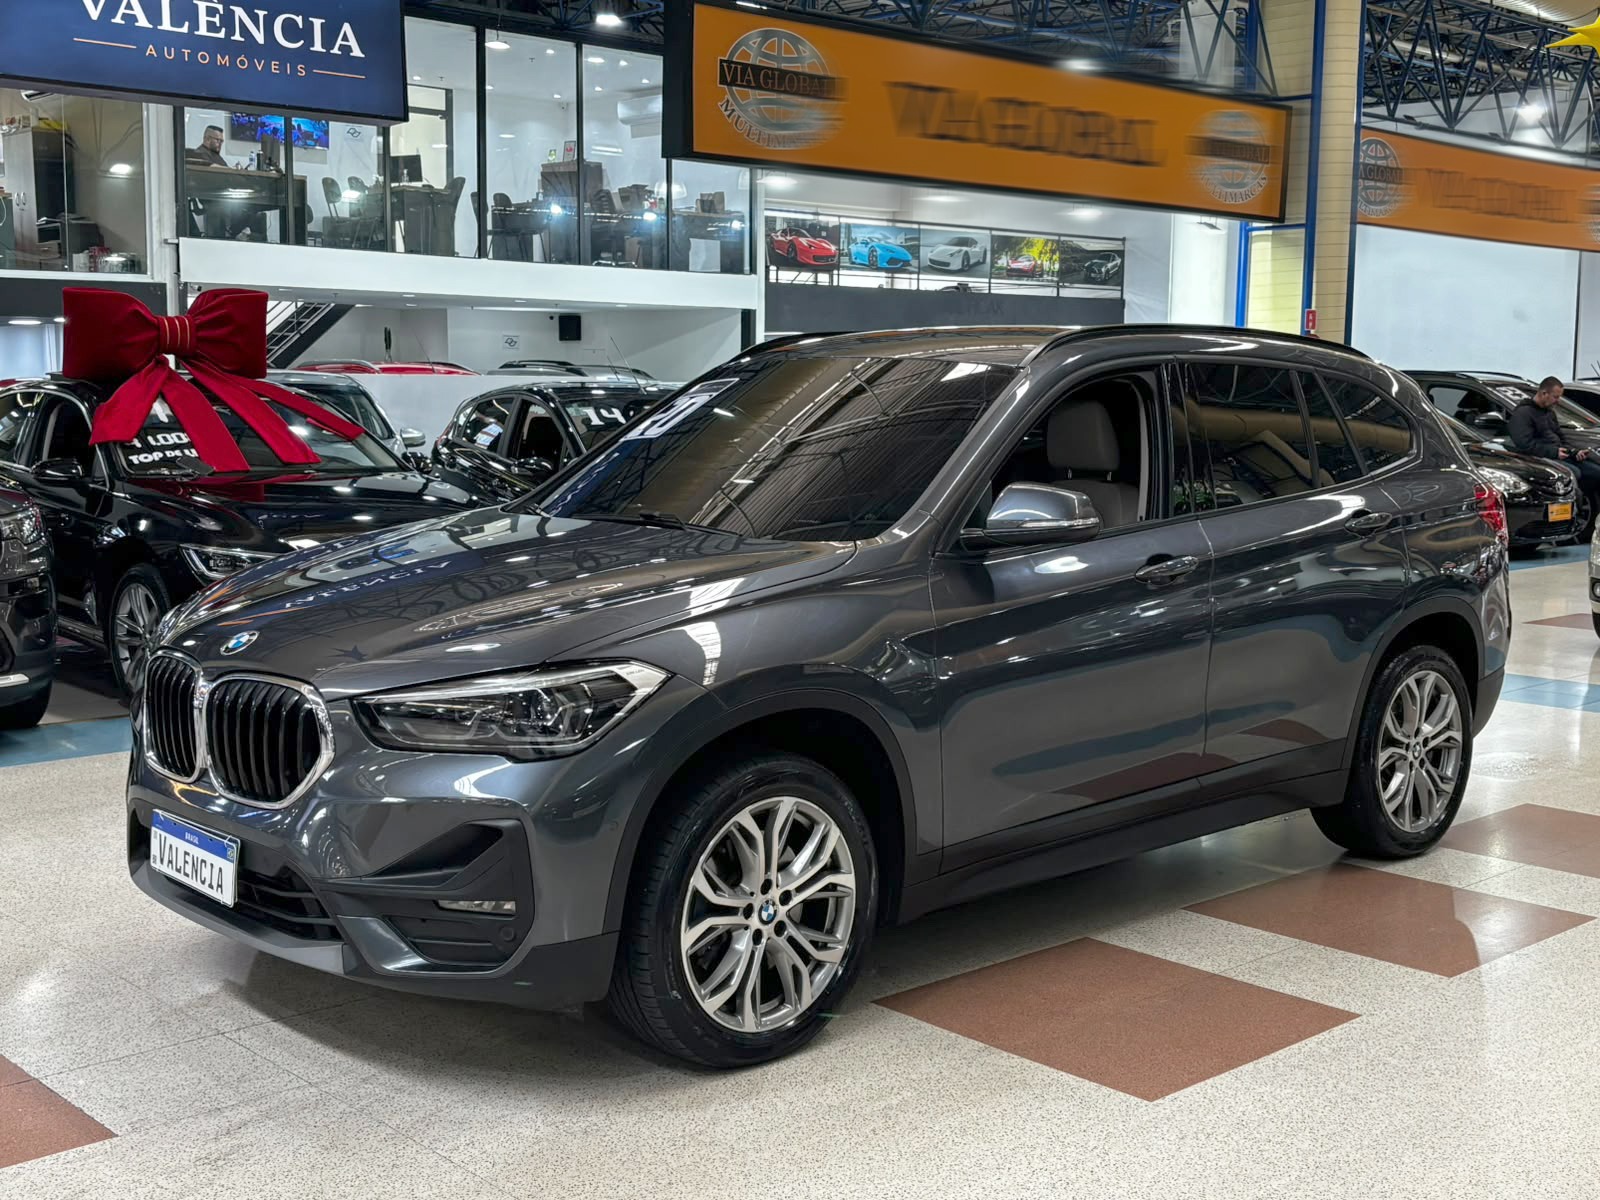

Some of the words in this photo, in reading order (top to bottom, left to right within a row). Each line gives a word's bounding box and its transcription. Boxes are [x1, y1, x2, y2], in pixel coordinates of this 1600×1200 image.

[81, 0, 365, 58] VALÊNCIA
[145, 44, 306, 77] AUTOMÓVEIS
[722, 62, 756, 87] VIA
[583, 407, 627, 425] 14
[147, 432, 191, 446] 1.00
[128, 451, 163, 464] TOP
[159, 833, 224, 895] VALENCIA
